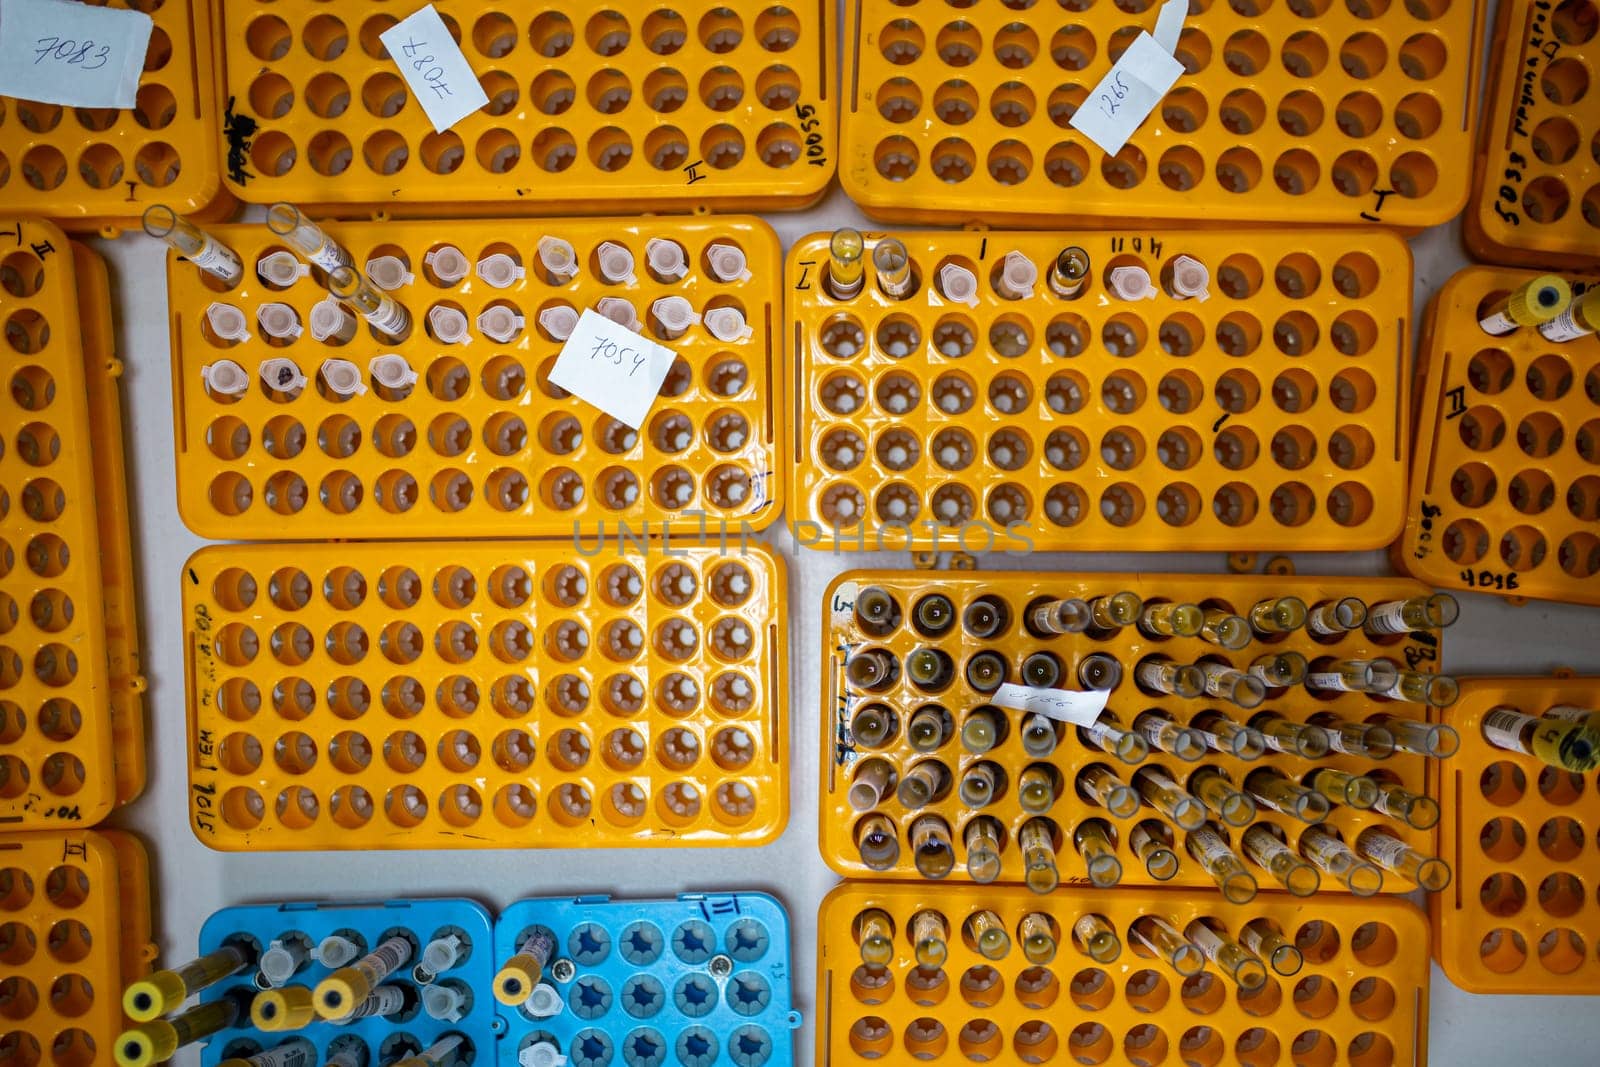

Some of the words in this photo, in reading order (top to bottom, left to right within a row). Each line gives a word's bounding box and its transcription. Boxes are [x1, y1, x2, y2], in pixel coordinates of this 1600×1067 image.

[34, 37, 111, 70] 7083
[402, 36, 453, 100] 7087
[1100, 70, 1131, 121] 1265
[592, 336, 646, 377] 7054
